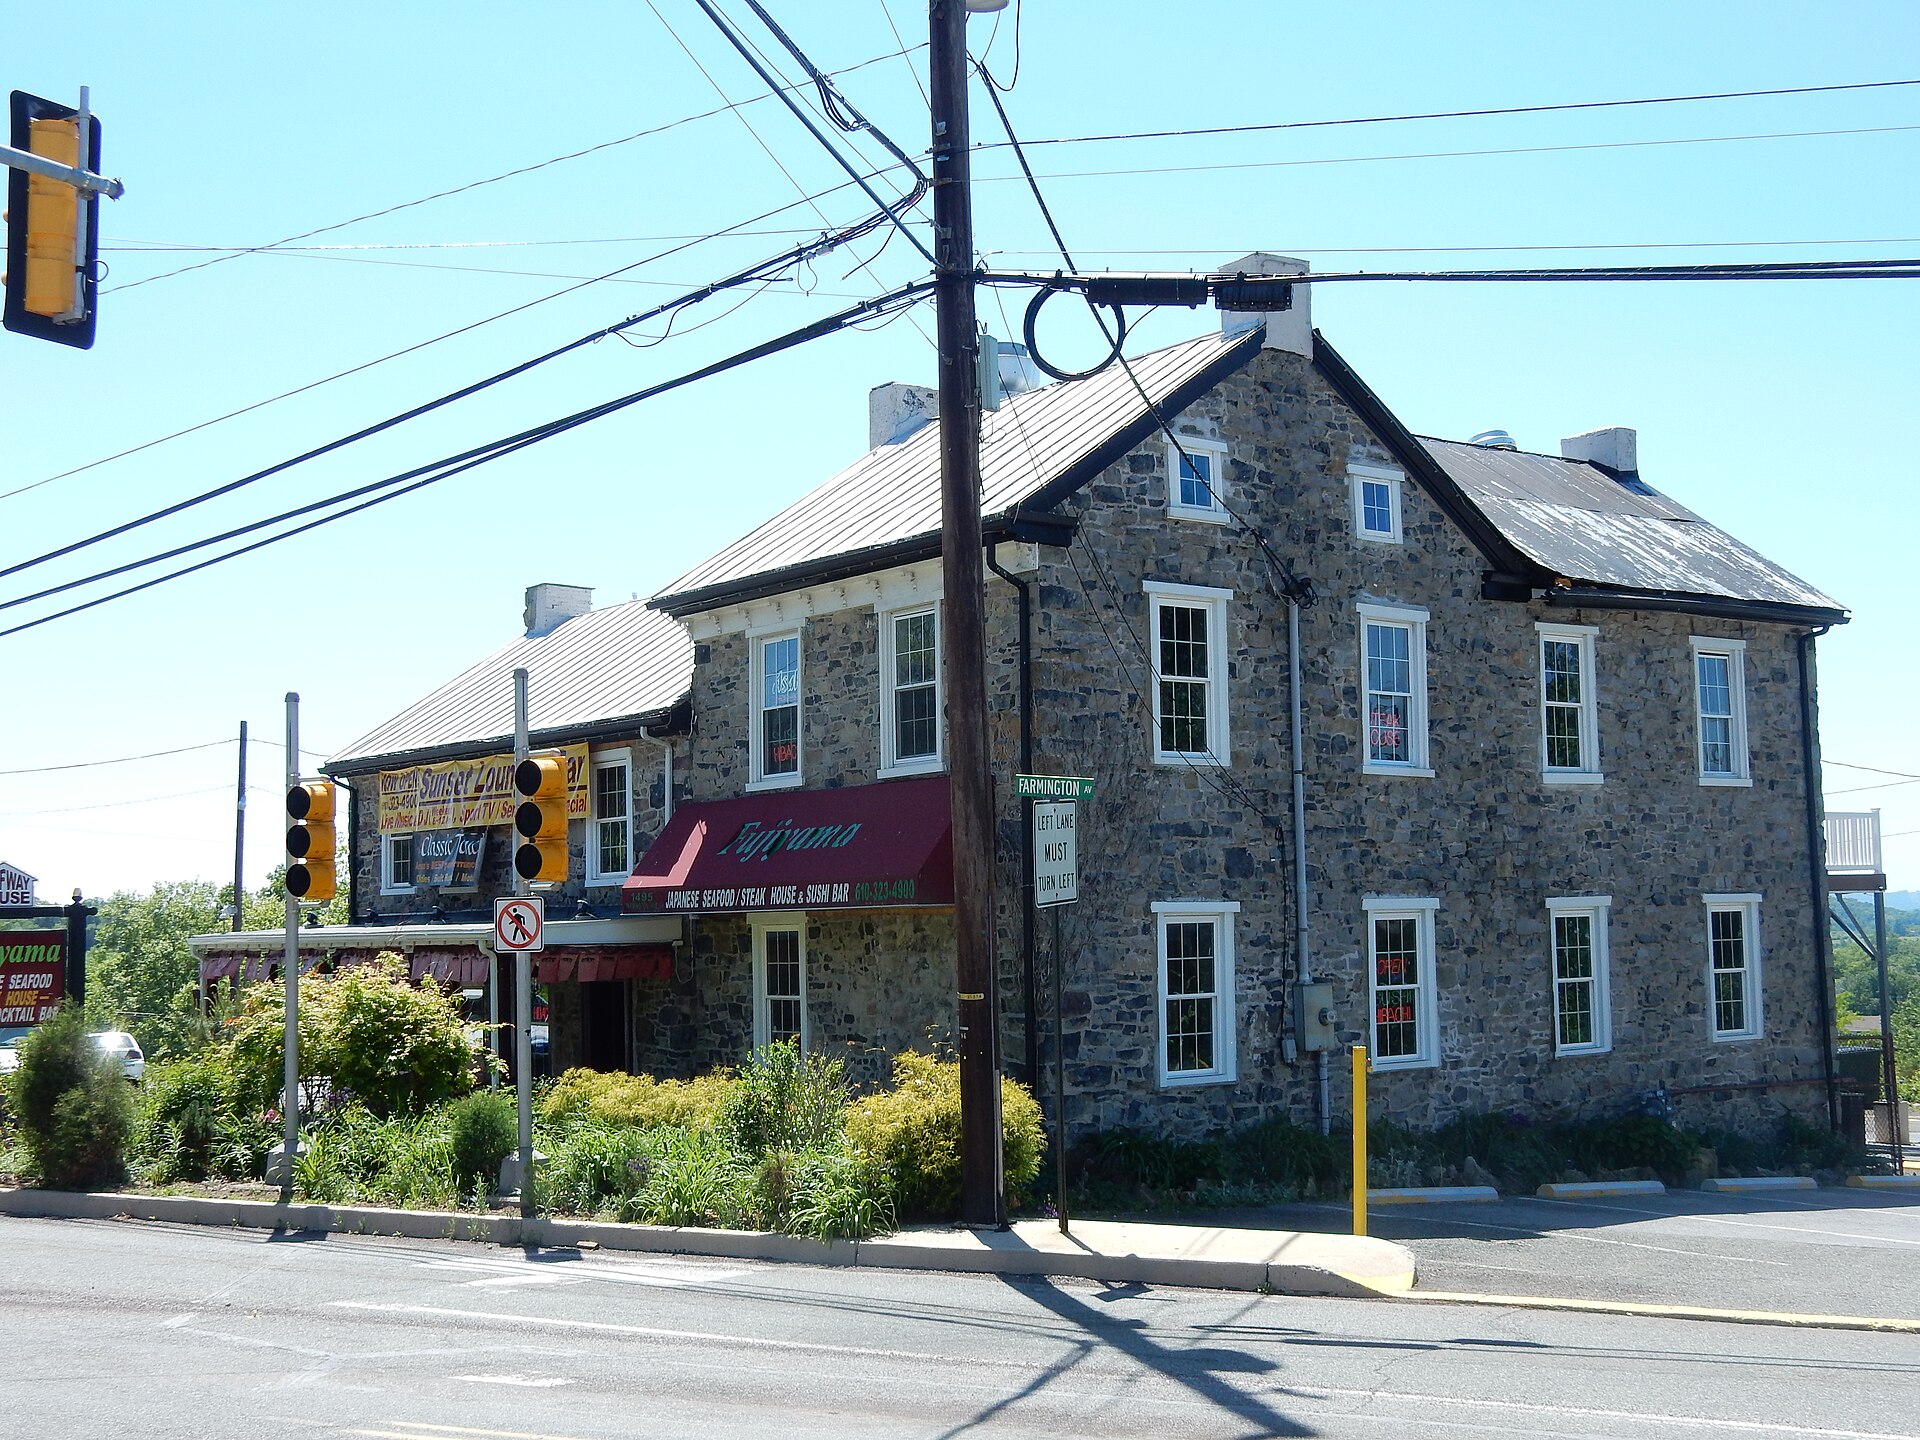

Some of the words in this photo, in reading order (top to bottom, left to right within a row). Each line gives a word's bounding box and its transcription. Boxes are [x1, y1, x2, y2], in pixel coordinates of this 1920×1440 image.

[1370, 712, 1401, 726] TEAK
[1371, 729, 1401, 746] OUSE
[420, 764, 473, 799] Sunset
[474, 761, 516, 795] Loun
[567, 755, 586, 784] ar
[1019, 778, 1080, 796] FARMINGTON
[1084, 785, 1092, 794] AV
[483, 801, 496, 819] TV
[568, 793, 587, 812] cial
[1038, 815, 1053, 831] LEFT
[1057, 813, 1073, 830] LANE
[421, 834, 452, 857] Classic
[717, 818, 862, 862] Fujiyama
[1044, 842, 1067, 862] MUST
[1038, 875, 1055, 892] TURN
[1059, 872, 1074, 889] LEFT
[665, 890, 700, 909] JAPANESE
[770, 885, 797, 905] HOUSE
[798, 891, 804, 904] &
[806, 884, 830, 904] SUSHI
[832, 883, 850, 903] BAR
[1377, 957, 1408, 975] OPEN
[9, 973, 53, 989] SEAFOOD
[6, 990, 39, 1006] HOUSE
[0, 1006, 34, 1022] CKTAIL
